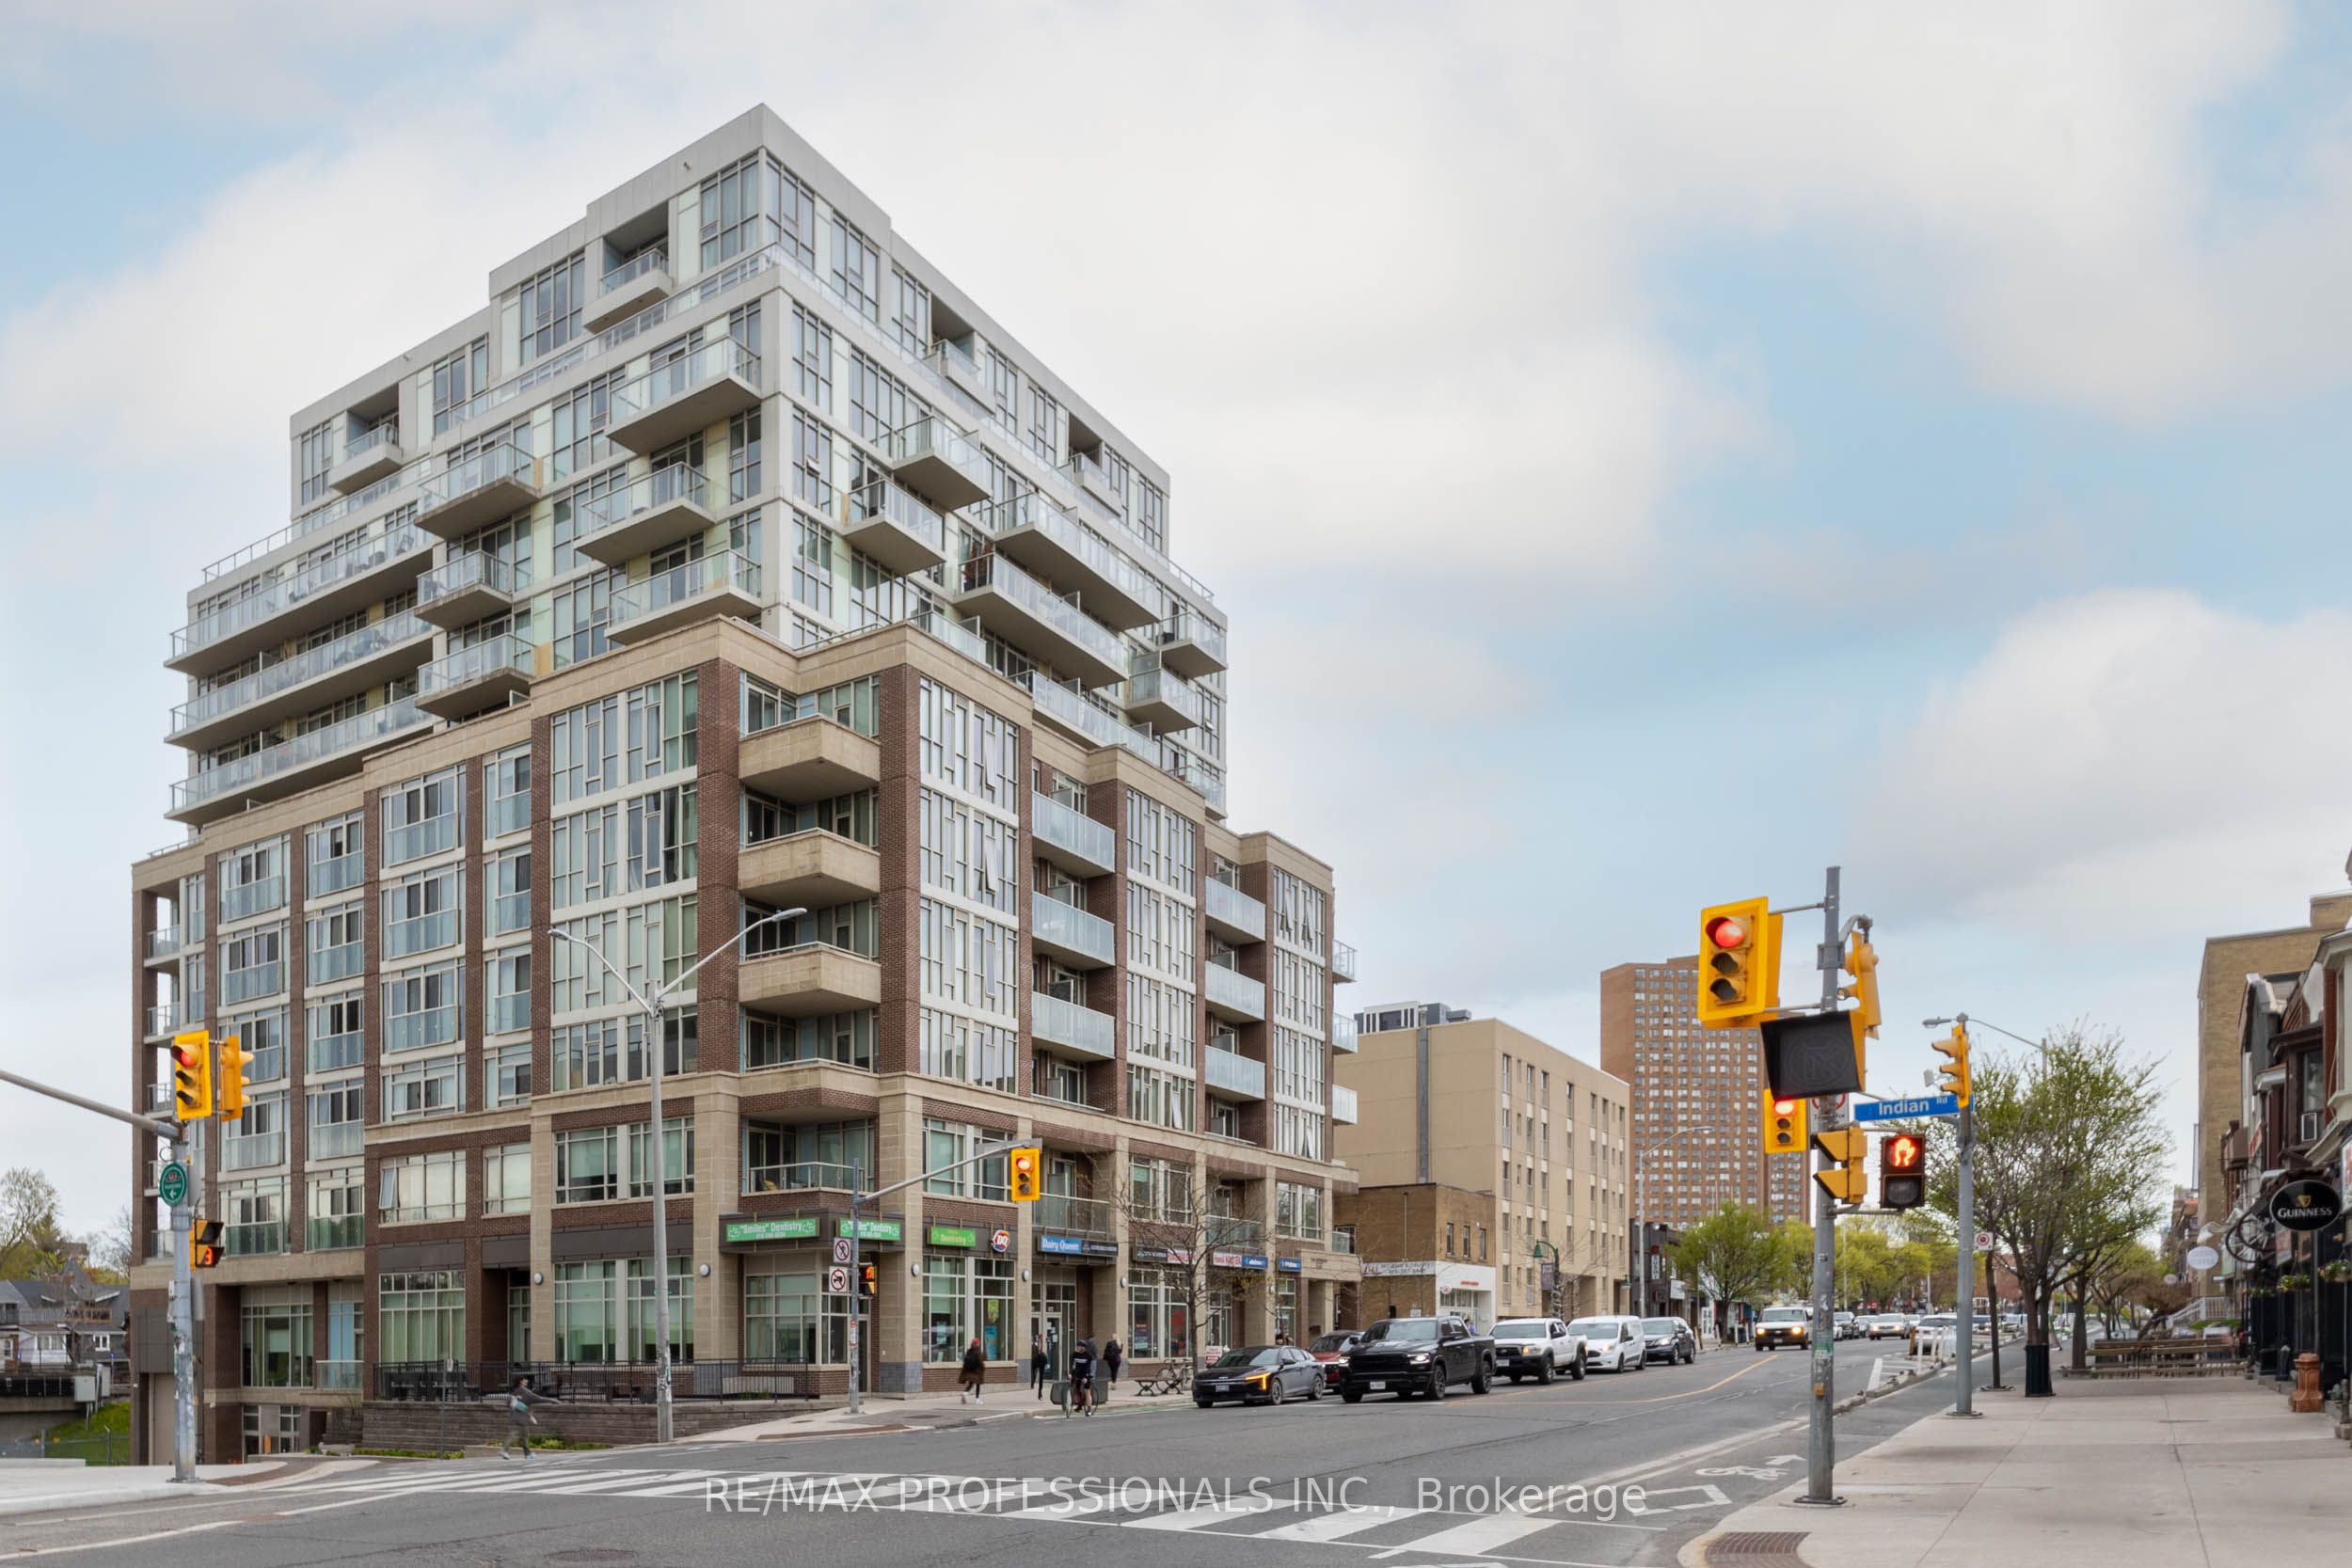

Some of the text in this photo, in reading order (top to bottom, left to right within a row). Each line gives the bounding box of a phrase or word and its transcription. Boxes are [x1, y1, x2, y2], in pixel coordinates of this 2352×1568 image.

[1879, 1100, 1929, 1116] Indian
[771, 1221, 803, 1234] Dentistry
[941, 1233, 966, 1245] Dentistry
[998, 1235, 1009, 1243] DQ
[1041, 1237, 1059, 1252] Dairy
[1059, 1239, 1079, 1251] Queen
